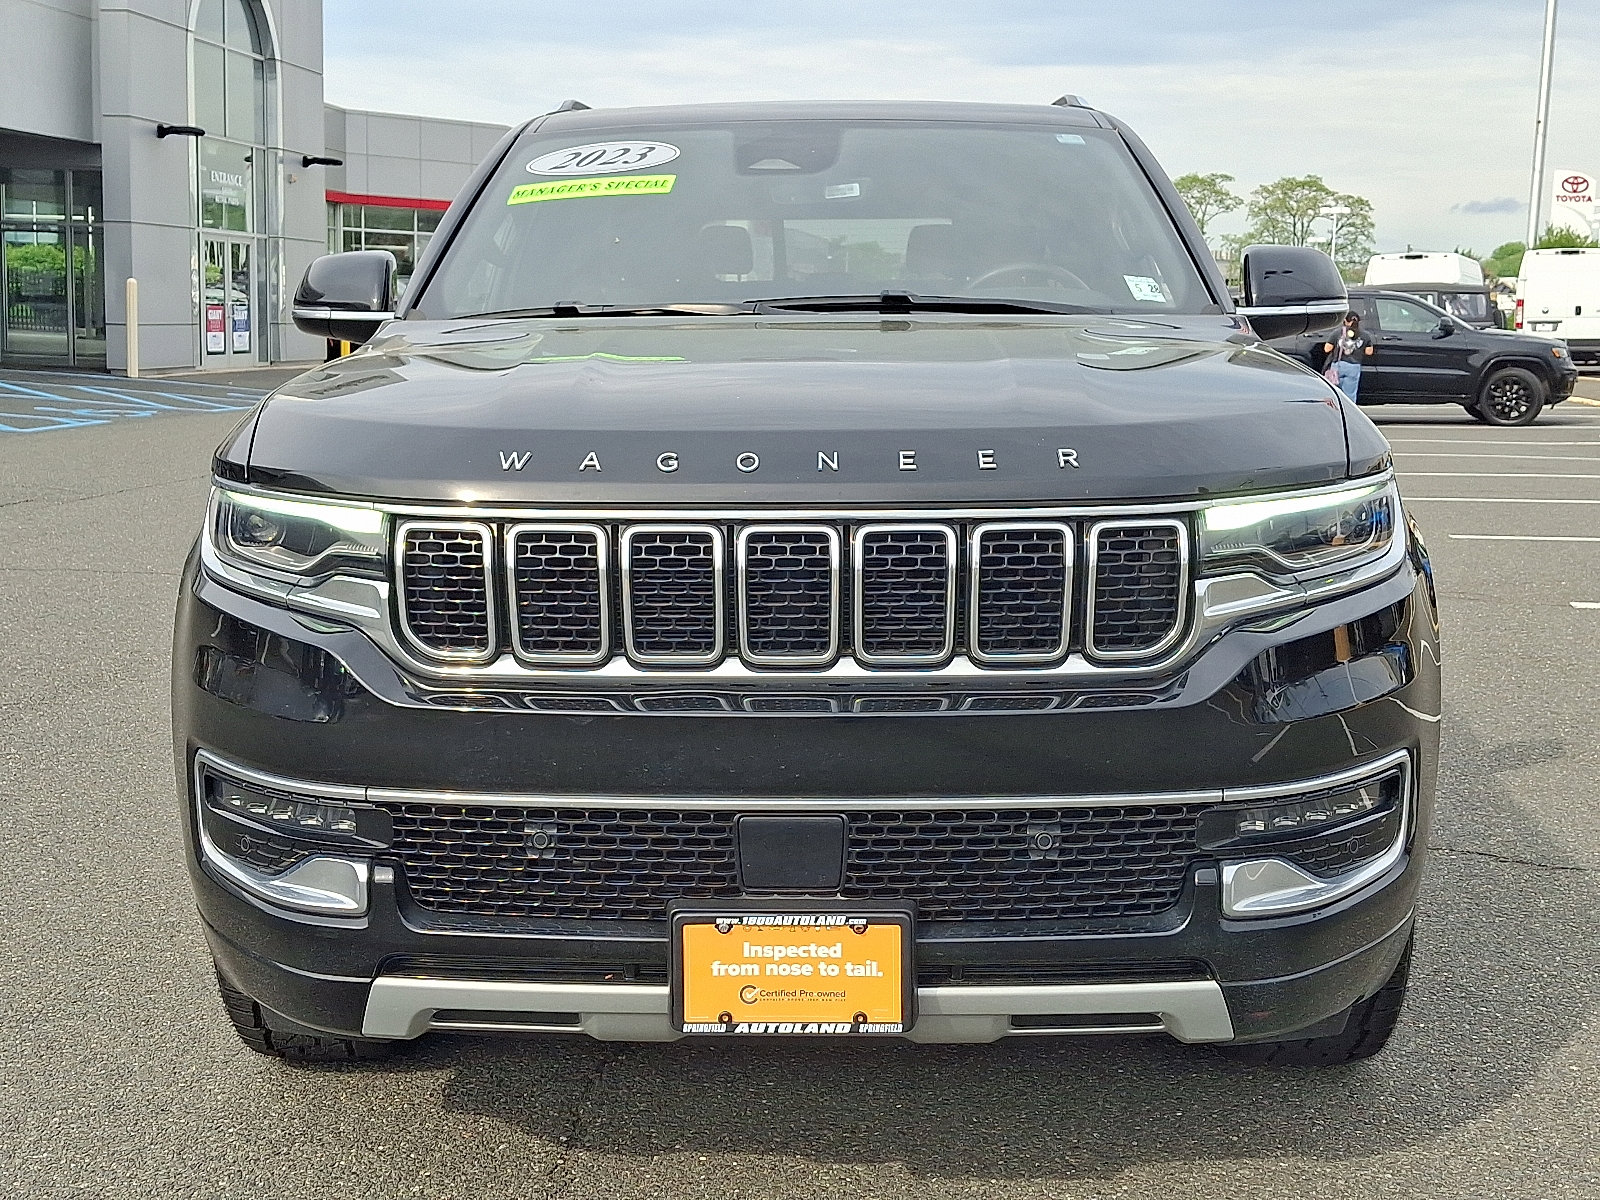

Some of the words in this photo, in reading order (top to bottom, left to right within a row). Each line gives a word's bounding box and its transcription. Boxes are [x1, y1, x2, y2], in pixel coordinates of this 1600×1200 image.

[547, 146, 657, 171] 2023
[211, 170, 242, 187] ENTRANCE
[512, 182, 601, 200] MANAGER'S
[604, 179, 669, 191] SPECIAL
[1556, 194, 1592, 203] TOYOTA
[1135, 283, 1142, 293] 5
[499, 447, 1080, 473] WAGONEER
[742, 941, 843, 961] Inspected
[710, 960, 760, 977] from
[765, 964, 813, 977] nose
[818, 961, 840, 977] to
[844, 960, 884, 977] tail.
[759, 989, 797, 998] Certified
[682, 1023, 727, 1033] SPRINGFIELD
[734, 1023, 852, 1034] AUTOLAND
[859, 1023, 903, 1033] SPRINGFIELD
